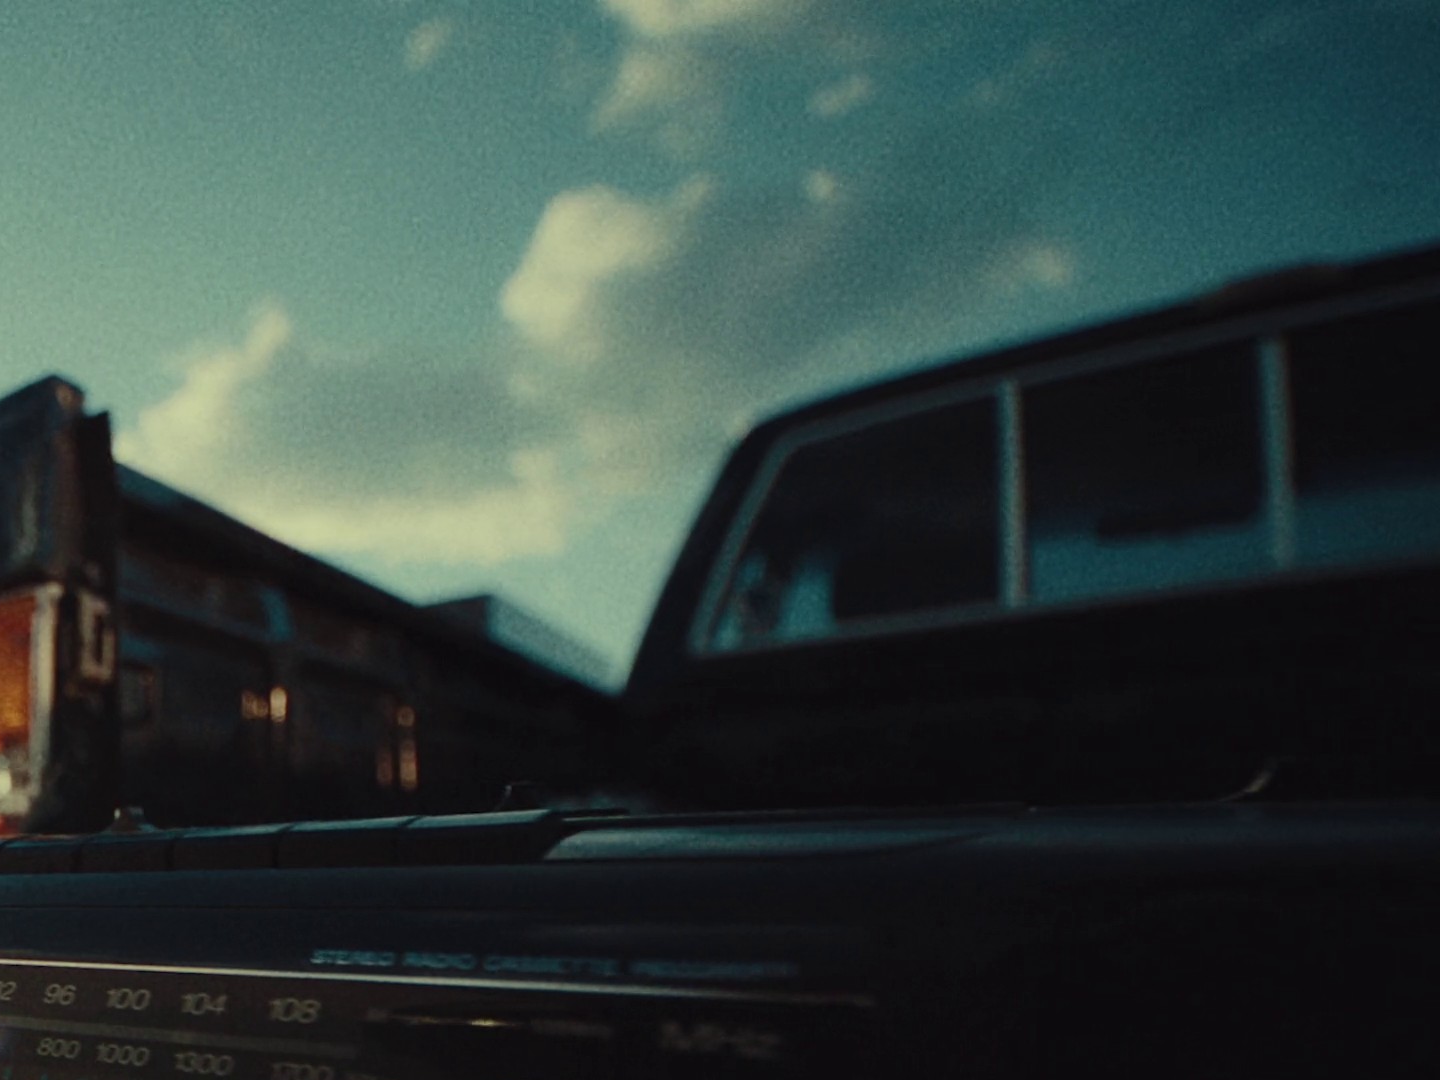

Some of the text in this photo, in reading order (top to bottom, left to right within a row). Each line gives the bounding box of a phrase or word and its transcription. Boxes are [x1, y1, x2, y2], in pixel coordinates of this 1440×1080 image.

[43, 983, 78, 1006] 96
[106, 988, 152, 1011] 100
[181, 992, 228, 1016] 104
[269, 997, 323, 1024] 108
[37, 1037, 82, 1060] 800
[96, 1043, 151, 1067] 1000
[174, 1052, 235, 1077] 1300
